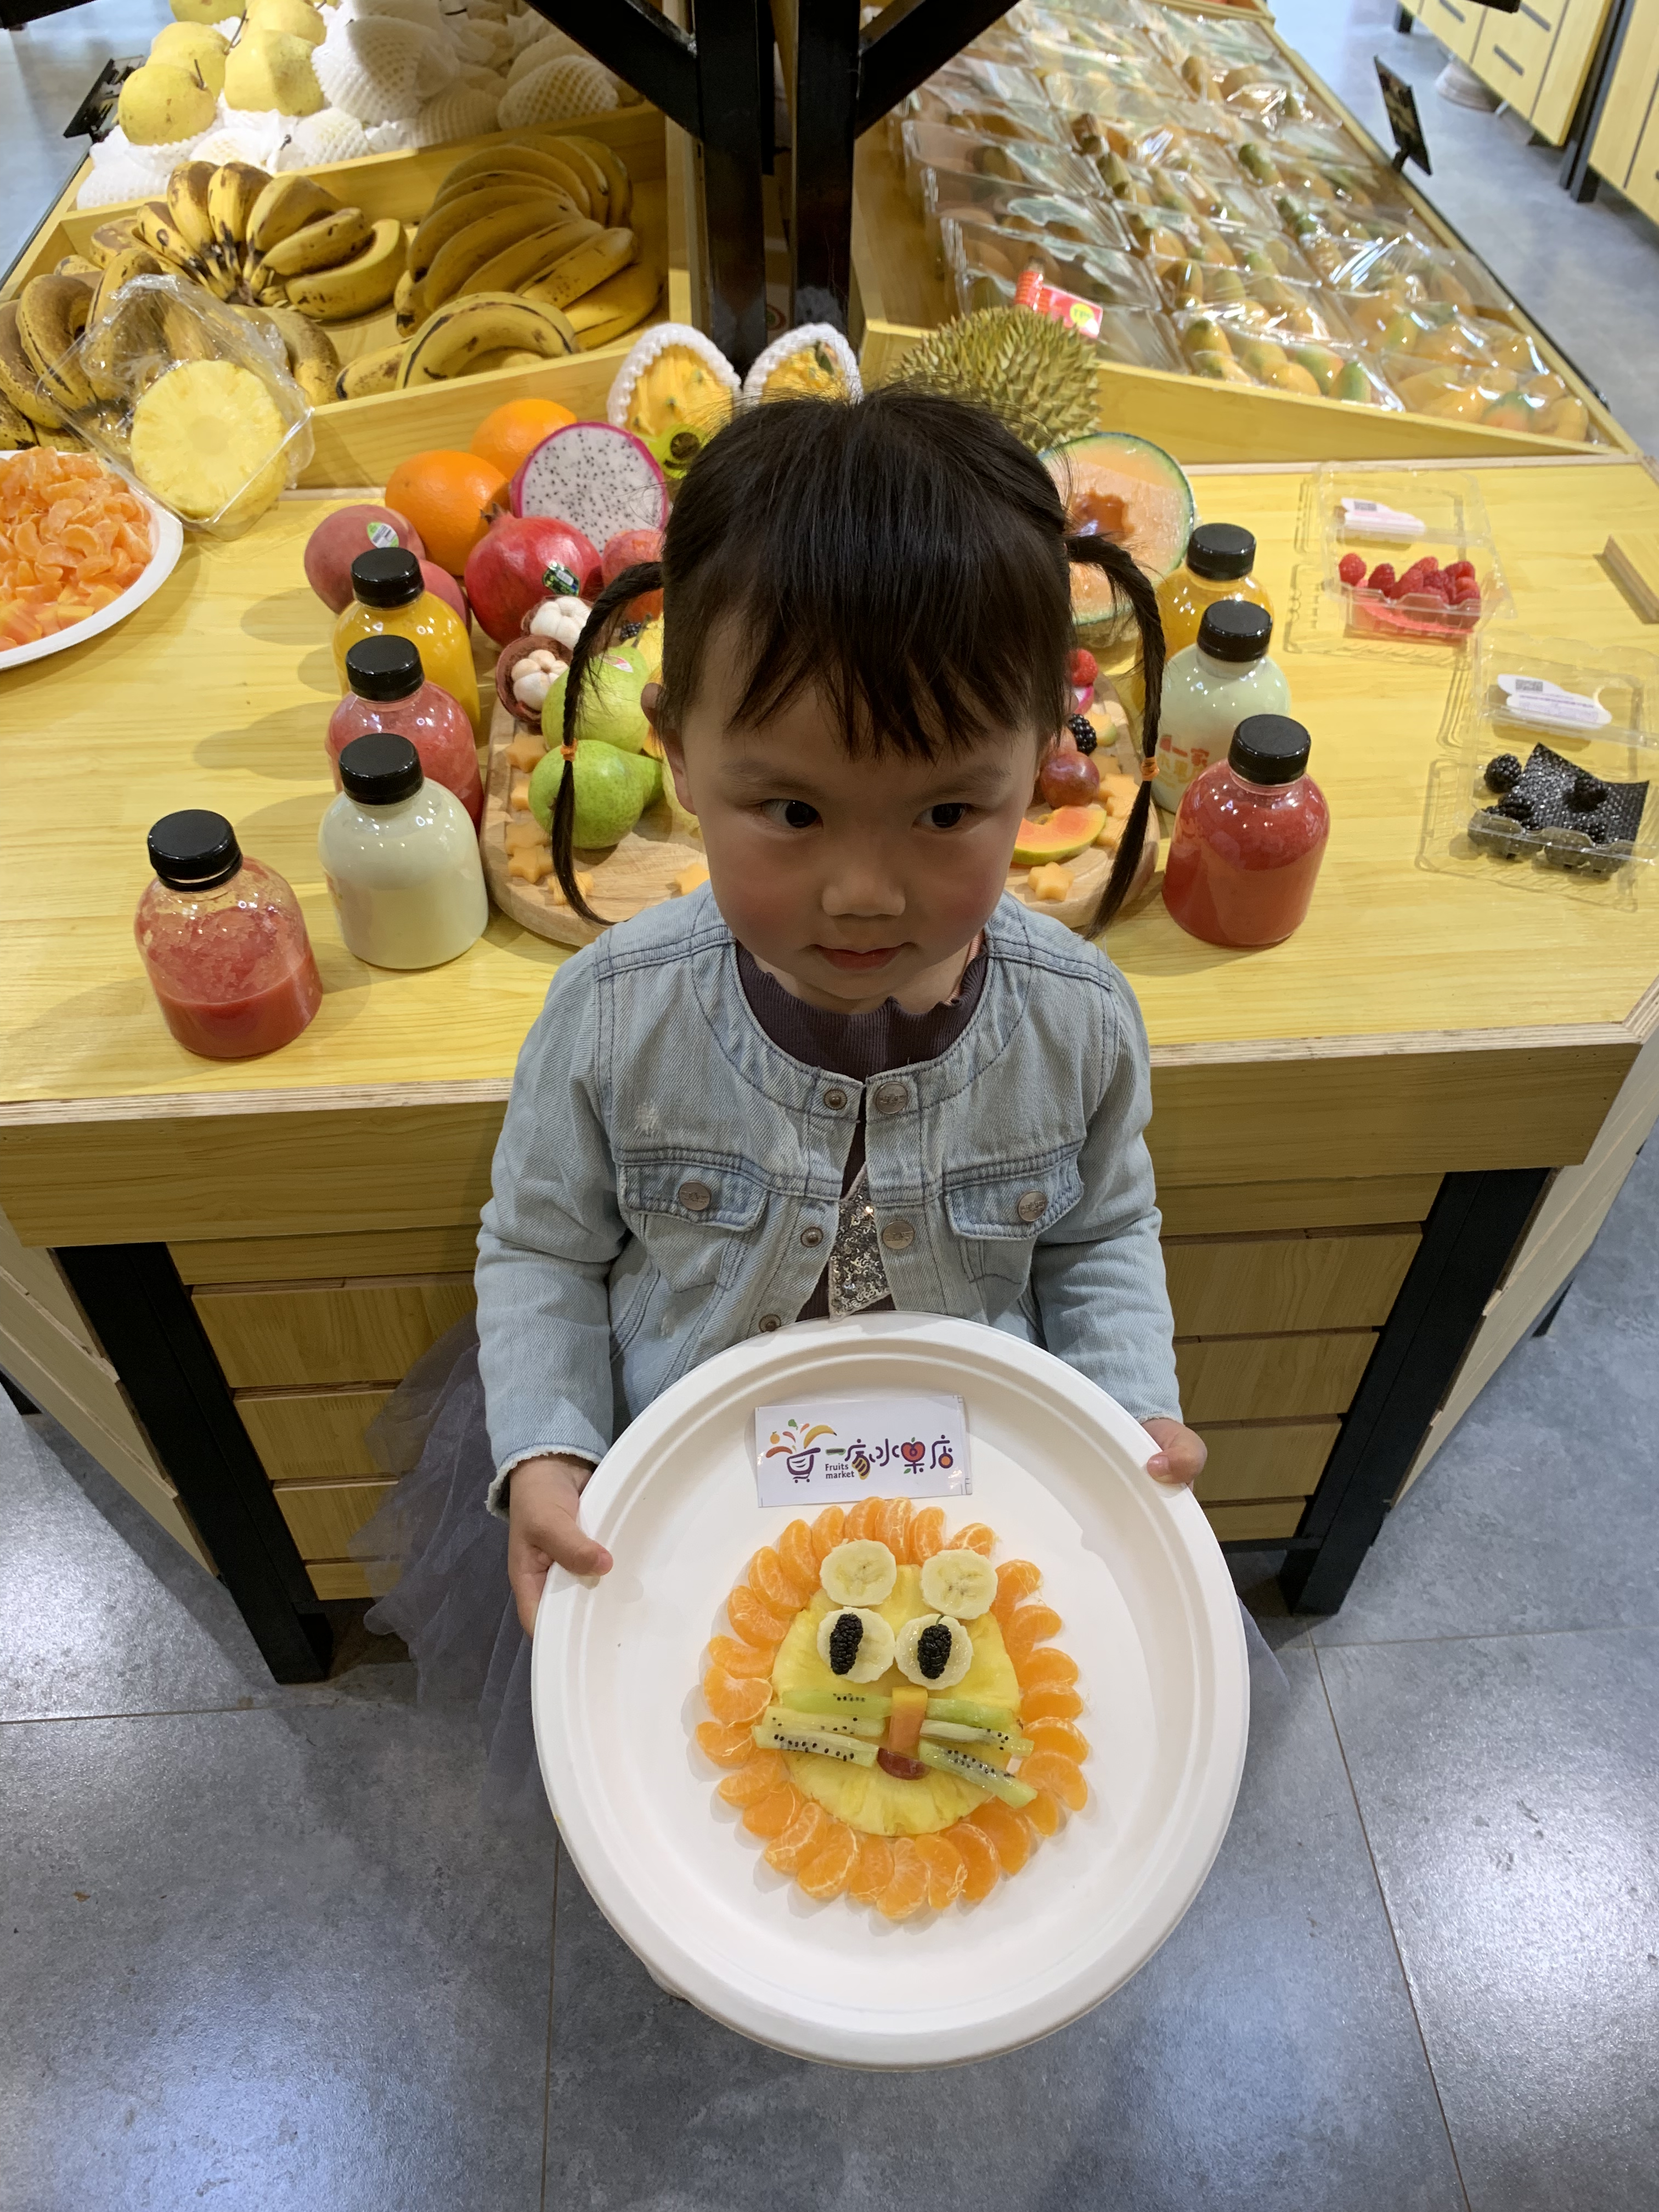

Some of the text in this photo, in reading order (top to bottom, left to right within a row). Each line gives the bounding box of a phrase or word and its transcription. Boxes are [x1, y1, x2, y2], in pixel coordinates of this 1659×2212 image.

[825, 1434, 954, 1480] 一家水果店
[825, 1463, 849, 1471] Fruits
[825, 1470, 855, 1480] market
